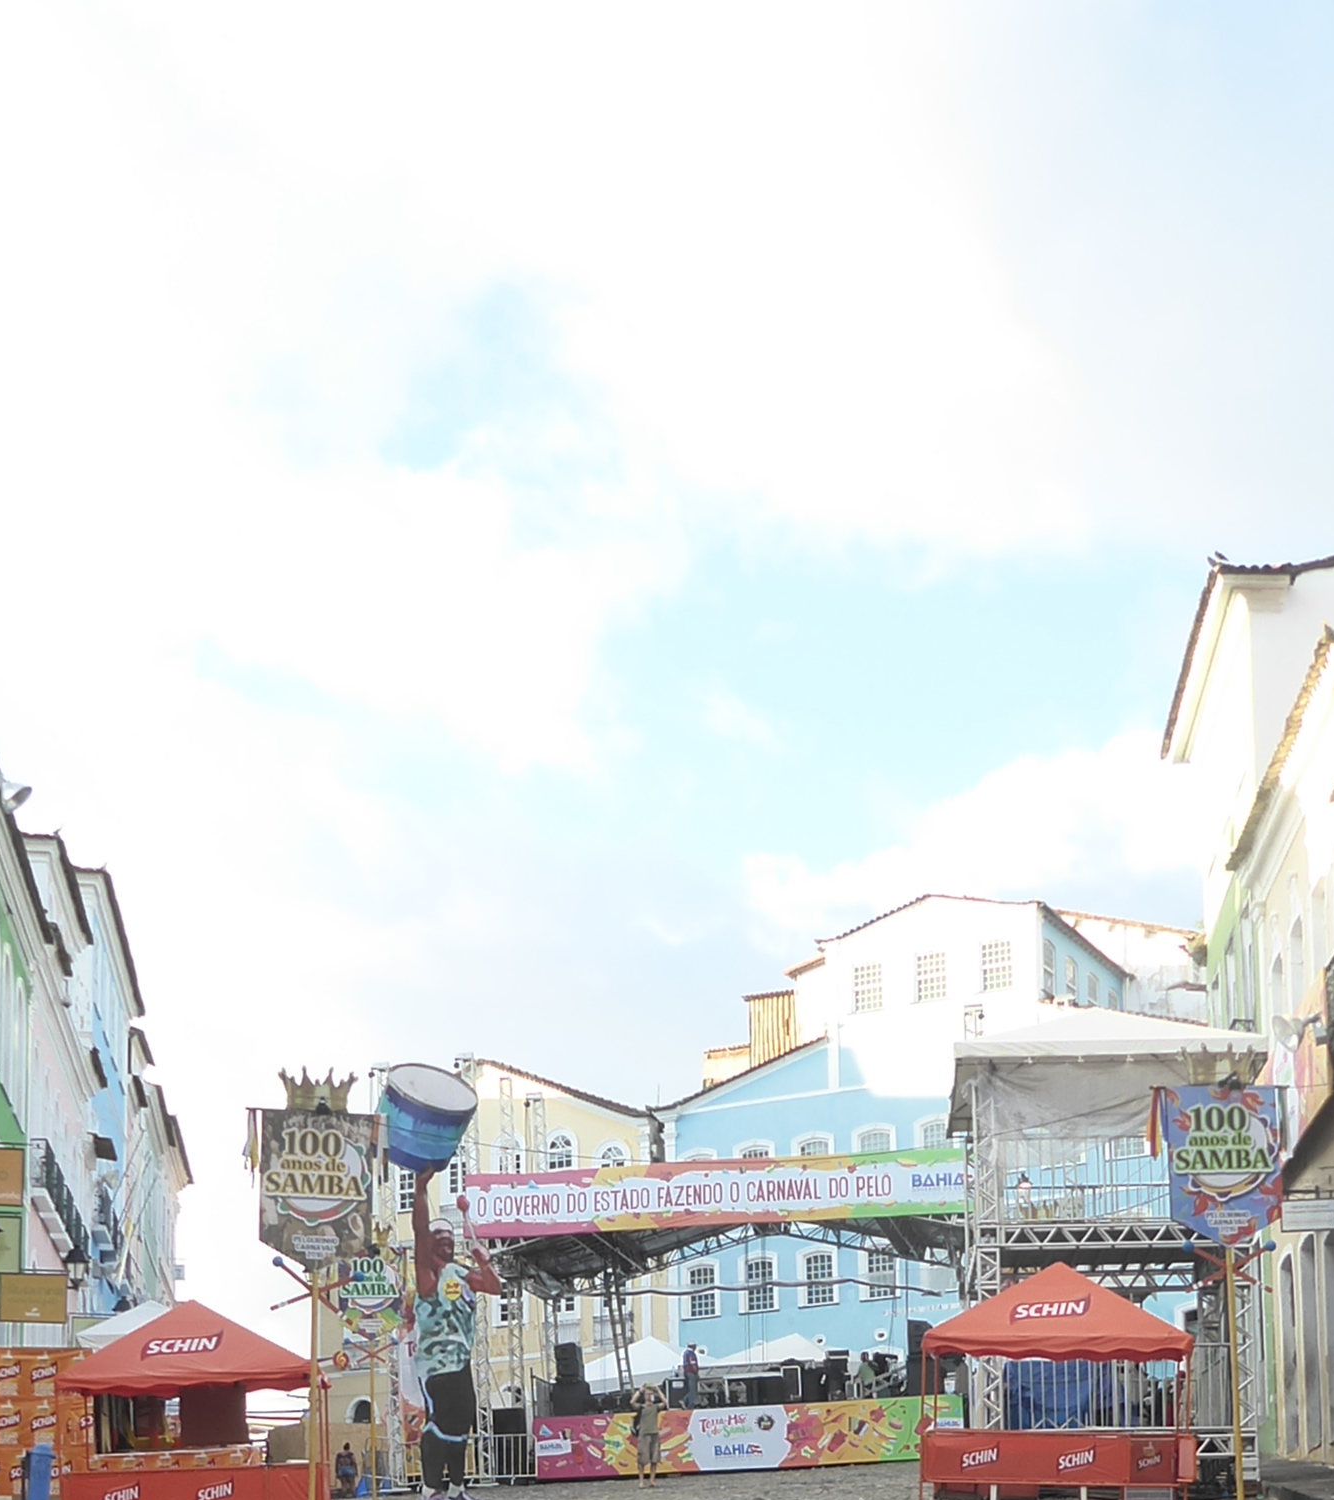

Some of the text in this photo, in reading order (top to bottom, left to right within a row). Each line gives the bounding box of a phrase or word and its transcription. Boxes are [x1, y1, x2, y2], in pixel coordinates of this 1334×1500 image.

[1189, 1106, 1247, 1132] 100
[283, 1129, 343, 1158] 100
[1189, 1131, 1252, 1147] anos de
[280, 1157, 347, 1172] anos de
[1175, 1148, 1272, 1170] SAMBA
[265, 1172, 364, 1197] SAMBA
[911, 1173, 965, 1187] BAHIA
[477, 1197, 487, 1218] O
[493, 1193, 560, 1217] GOVERNO
[566, 1191, 587, 1213] DO
[593, 1187, 651, 1212] ESTADO
[657, 1183, 723, 1208] FAZENDO
[729, 1181, 740, 1203] O
[747, 1177, 822, 1202] CARNAVAL
[829, 1176, 848, 1199] DO
[351, 1258, 385, 1274] 100
[341, 1283, 398, 1296] SAMBA
[1015, 1301, 1085, 1319] SCHIN
[146, 1336, 219, 1355] SCHIN
[31, 1365, 57, 1381] SCHIN
[31, 1413, 57, 1430] SCHIN
[714, 1443, 758, 1456] BAHIA
[962, 1448, 998, 1468] SCHIN
[1058, 1450, 1094, 1470] SCHIN
[1138, 1454, 1161, 1469] SCHIN
